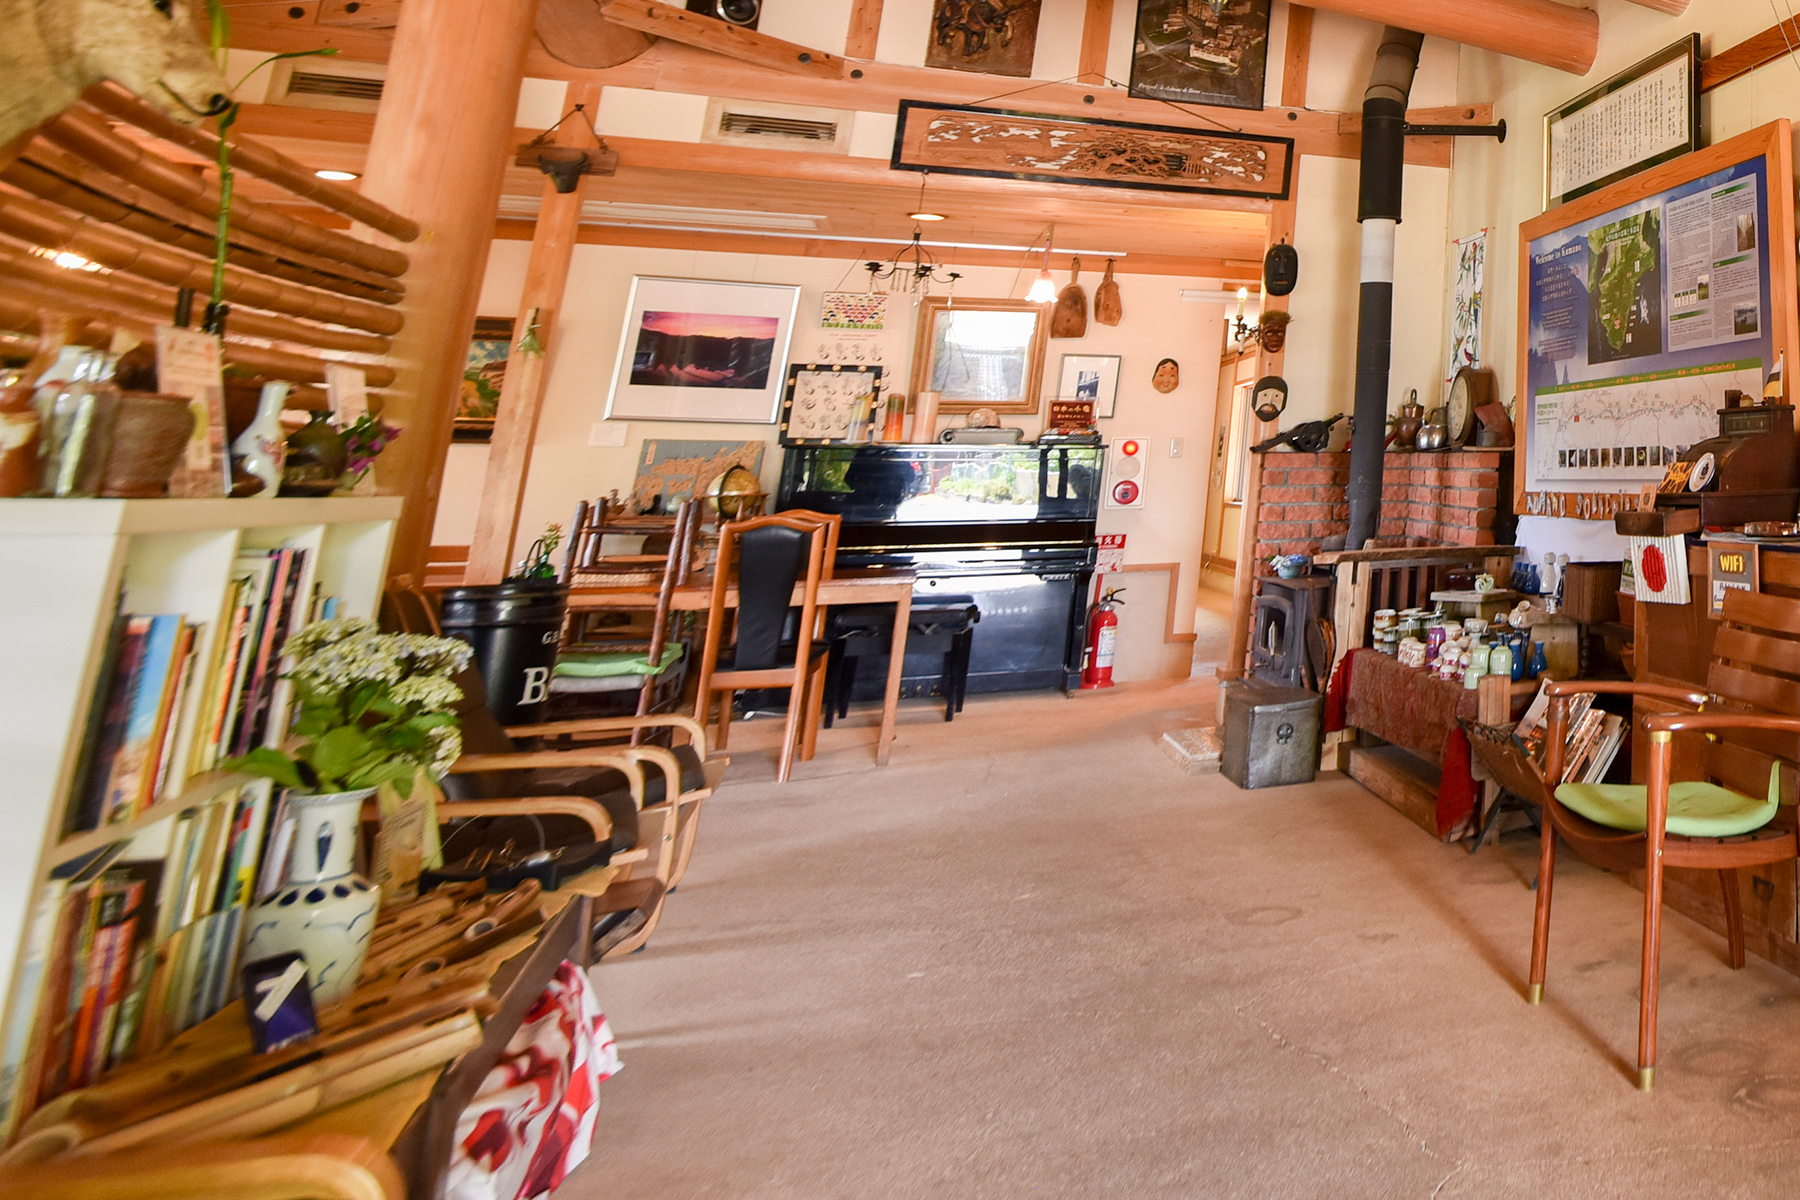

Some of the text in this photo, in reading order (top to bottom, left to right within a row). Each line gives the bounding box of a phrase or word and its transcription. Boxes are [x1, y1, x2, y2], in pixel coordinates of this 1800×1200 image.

[1535, 251, 1555, 265] Welcome
[1561, 243, 1582, 257] Kumano
[1719, 554, 1744, 573] WIFI
